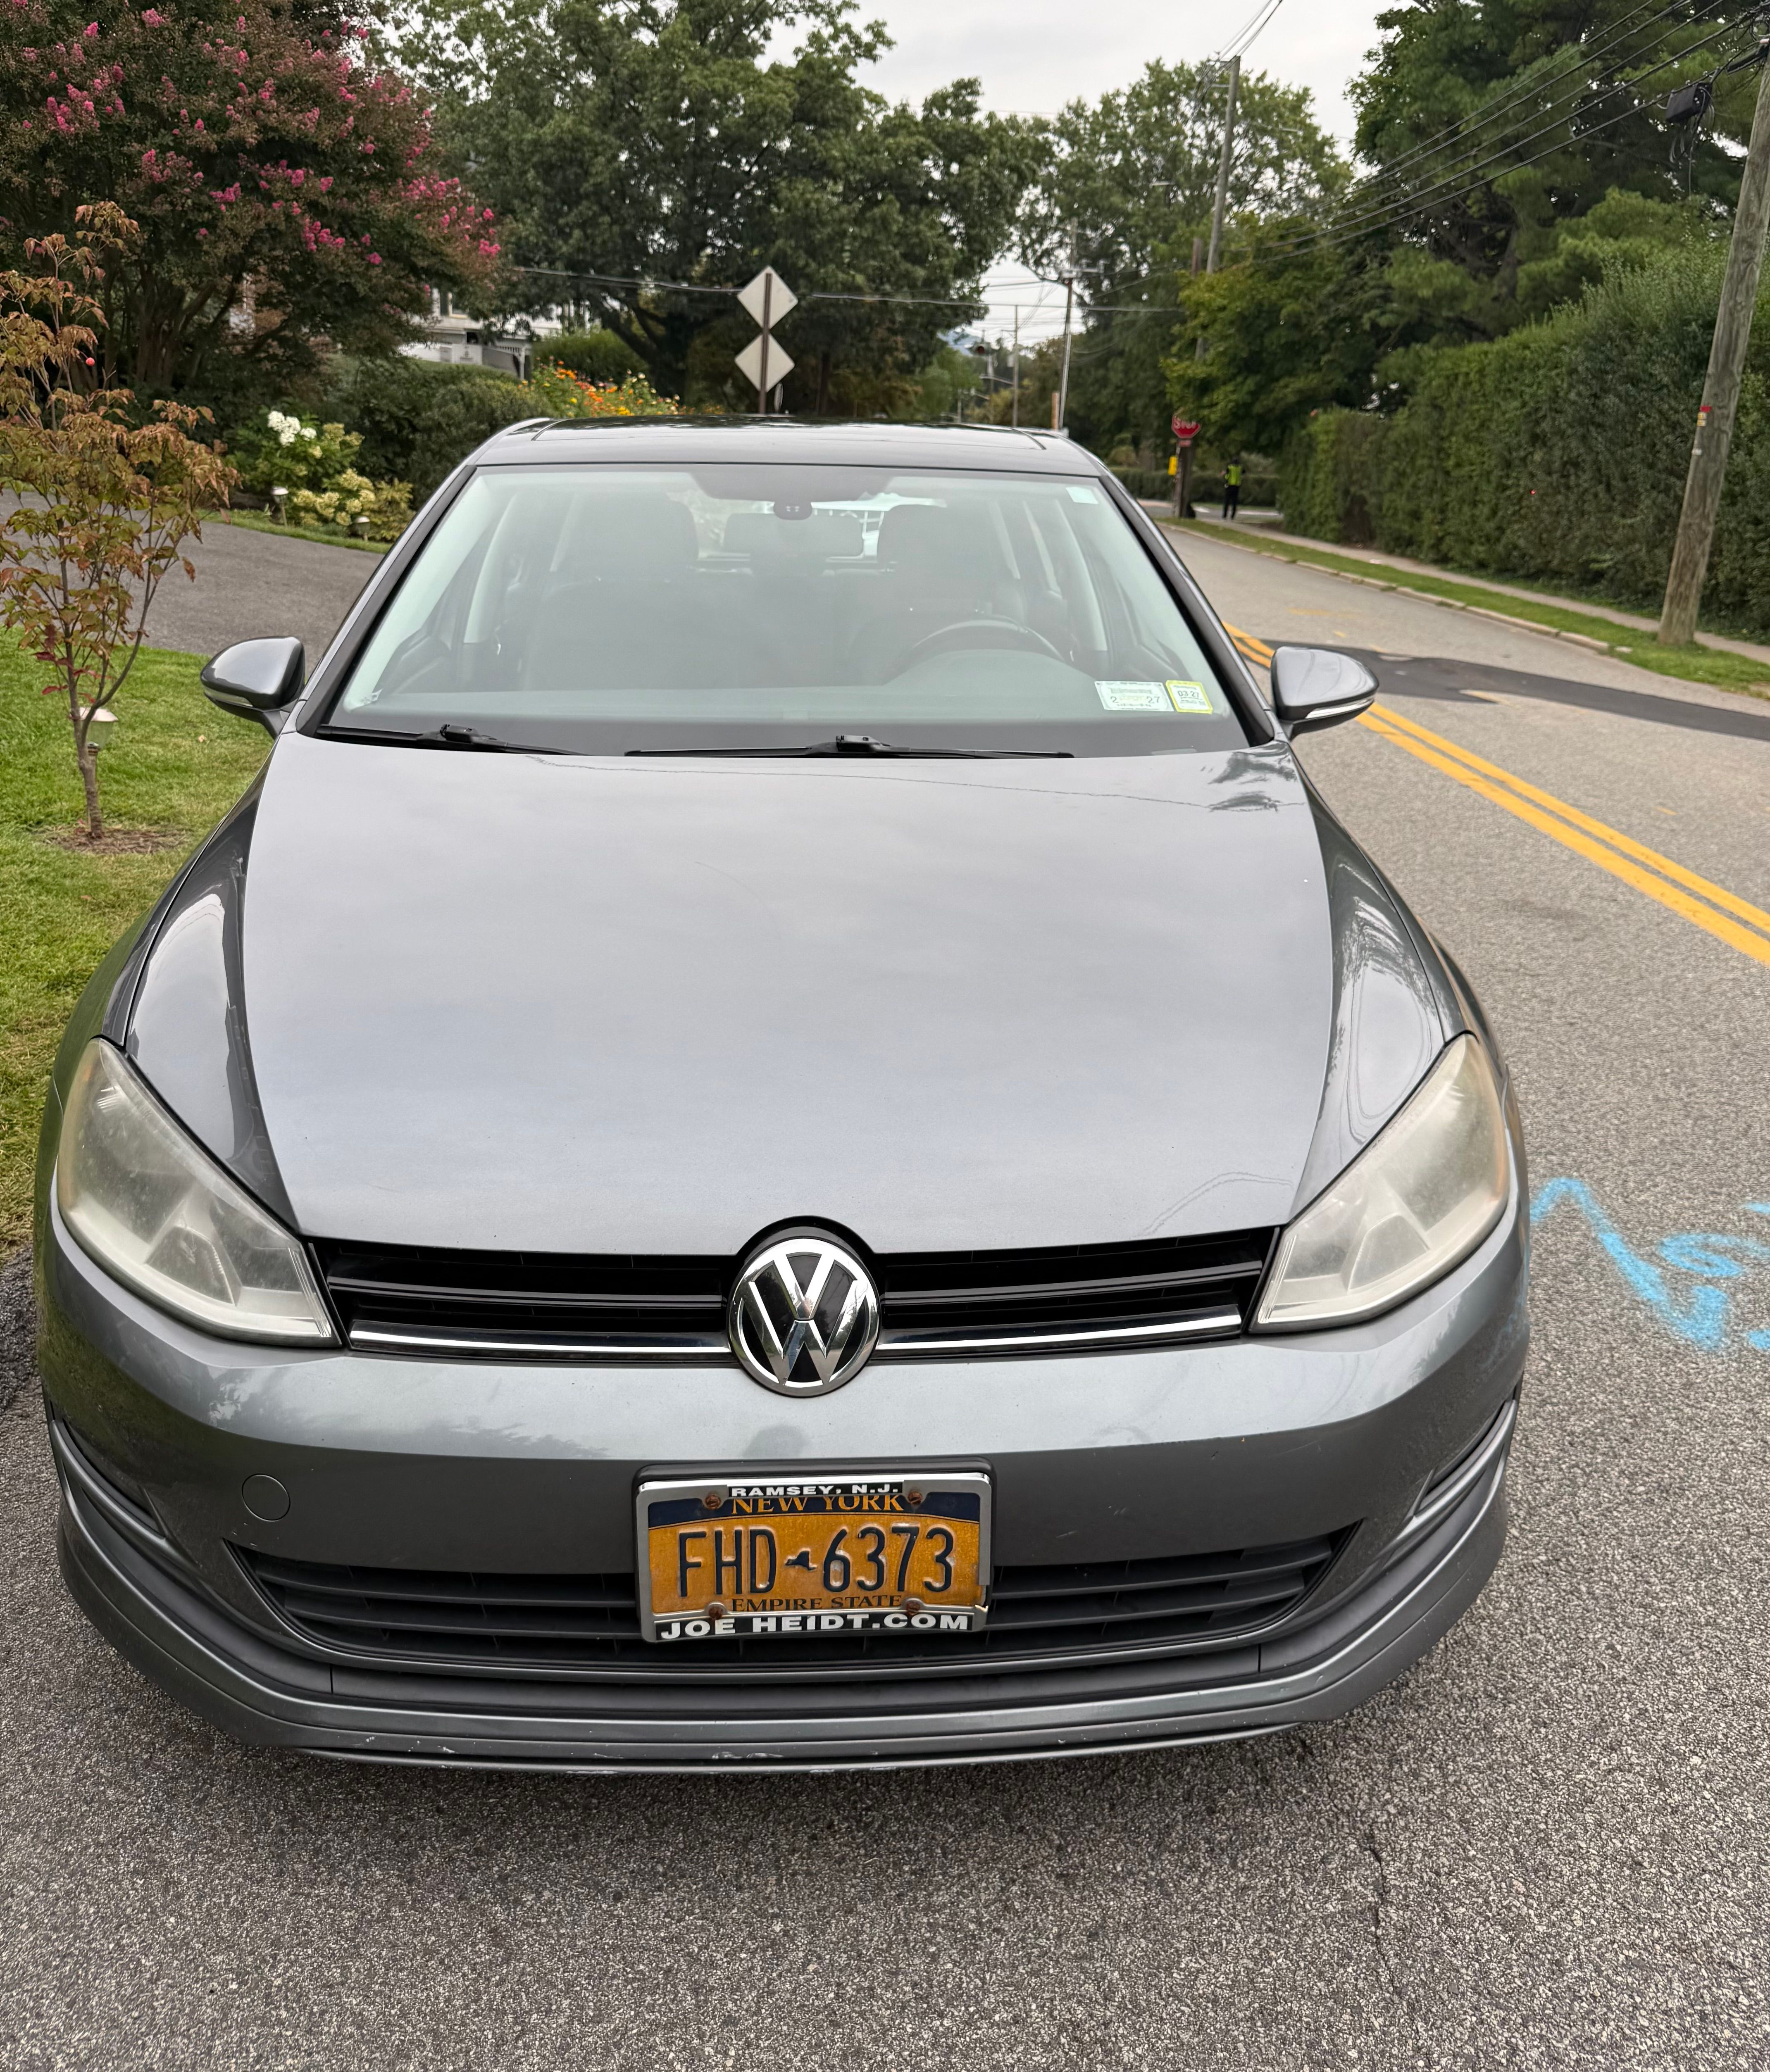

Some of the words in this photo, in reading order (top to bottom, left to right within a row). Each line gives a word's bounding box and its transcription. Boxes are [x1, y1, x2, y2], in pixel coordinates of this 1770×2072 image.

[731, 1485, 841, 1496] RAMSEY,
[852, 1484, 898, 1494] N.J.
[732, 1496, 808, 1515] NEW
[823, 1495, 904, 1511] YORK
[679, 1529, 777, 1597] FHD
[823, 1526, 954, 1593] 6373
[731, 1598, 823, 1612] EMPIRE
[831, 1595, 902, 1608] STATE
[661, 1618, 736, 1639] JOE
[752, 1613, 968, 1633] HEIDT.COM
